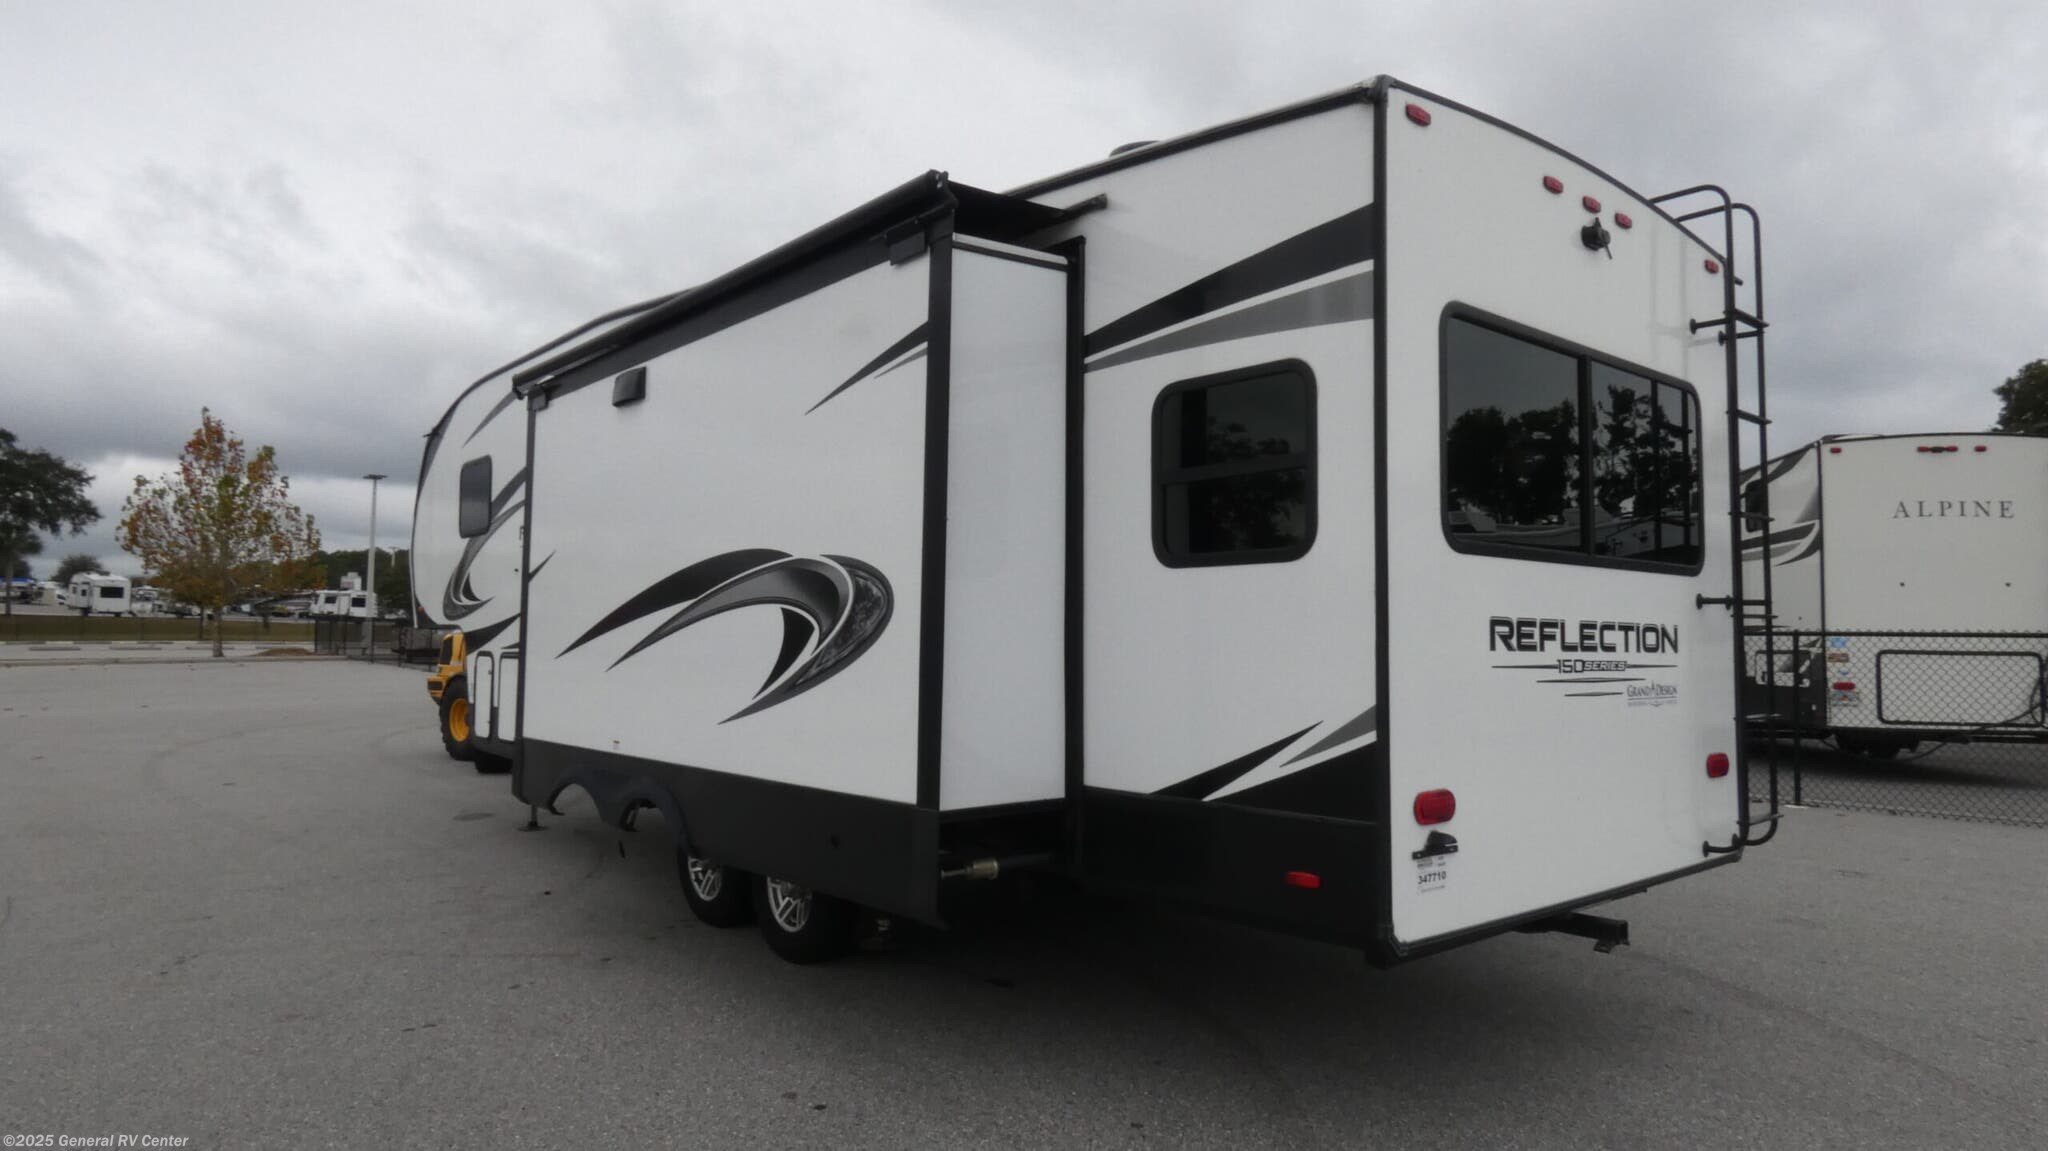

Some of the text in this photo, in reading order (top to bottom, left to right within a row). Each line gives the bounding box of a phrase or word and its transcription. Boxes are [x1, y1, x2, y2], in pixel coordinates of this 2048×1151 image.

[1893, 500, 2015, 519] ALPINE
[1489, 615, 1679, 655] REFLECTION
[1557, 659, 1627, 674] 150 SERIES
[1417, 870, 1447, 885] 347710
